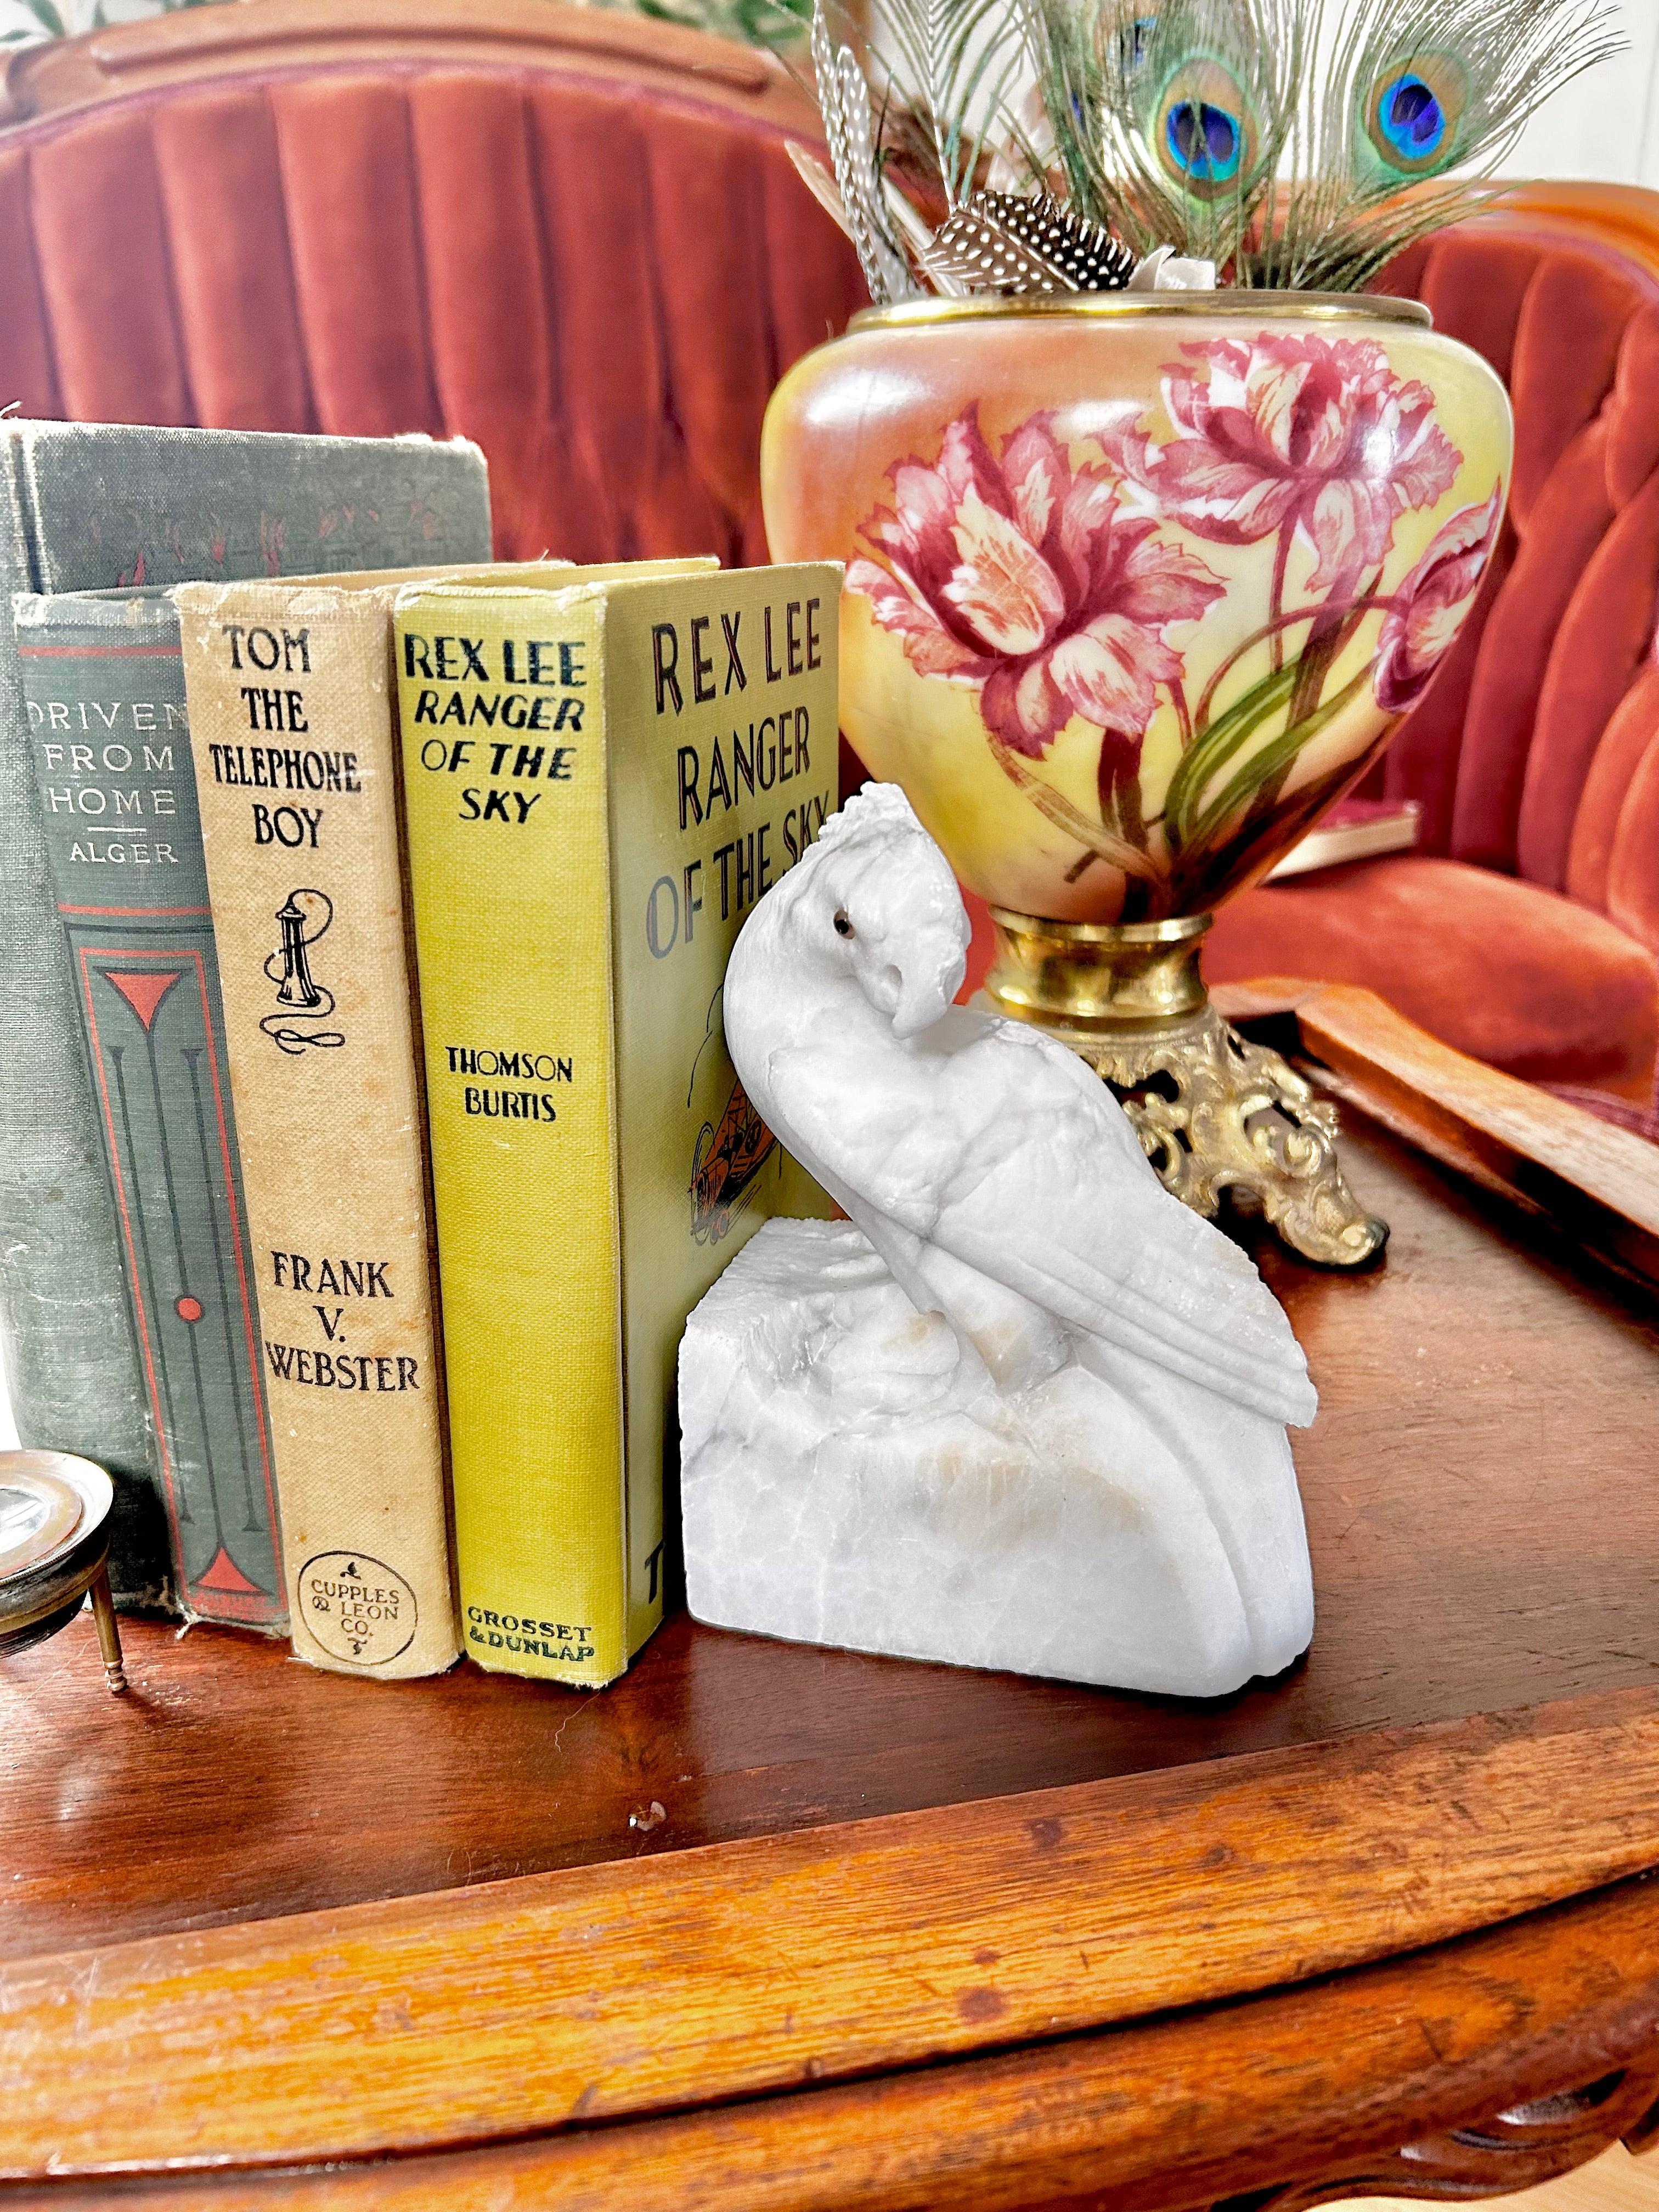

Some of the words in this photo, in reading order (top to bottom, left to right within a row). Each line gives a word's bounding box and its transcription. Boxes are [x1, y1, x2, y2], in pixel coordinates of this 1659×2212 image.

[222, 625, 312, 673] TOM
[404, 634, 490, 682] REX
[502, 639, 588, 688] LEE
[651, 611, 747, 716] REX
[764, 597, 822, 684] LEE
[241, 687, 309, 732] THE
[414, 690, 585, 732] RANGER
[43, 744, 175, 771] FROM
[208, 743, 362, 793] TELEPHONE
[421, 739, 476, 773] OF
[489, 743, 578, 780] THE
[678, 706, 811, 832] RANGER
[48, 788, 176, 815] HOME
[458, 788, 541, 825] SKY
[252, 804, 324, 848] BOY
[69, 842, 179, 864] ALGER
[646, 859, 703, 959] OF
[713, 822, 774, 922] THE
[783, 790, 830, 877] SKY
[445, 1046, 573, 1083] THOMSON
[465, 1087, 556, 1123] BURTIS
[270, 1250, 395, 1299] FRANK
[312, 1305, 347, 1342] V.
[264, 1341, 421, 1392] WEBSTER
[311, 1578, 400, 1604] CUPPLES
[312, 1595, 331, 1612] &
[341, 1601, 399, 1620] LEON
[341, 1618, 374, 1637] CO.
[467, 1606, 592, 1642] GROSSET
